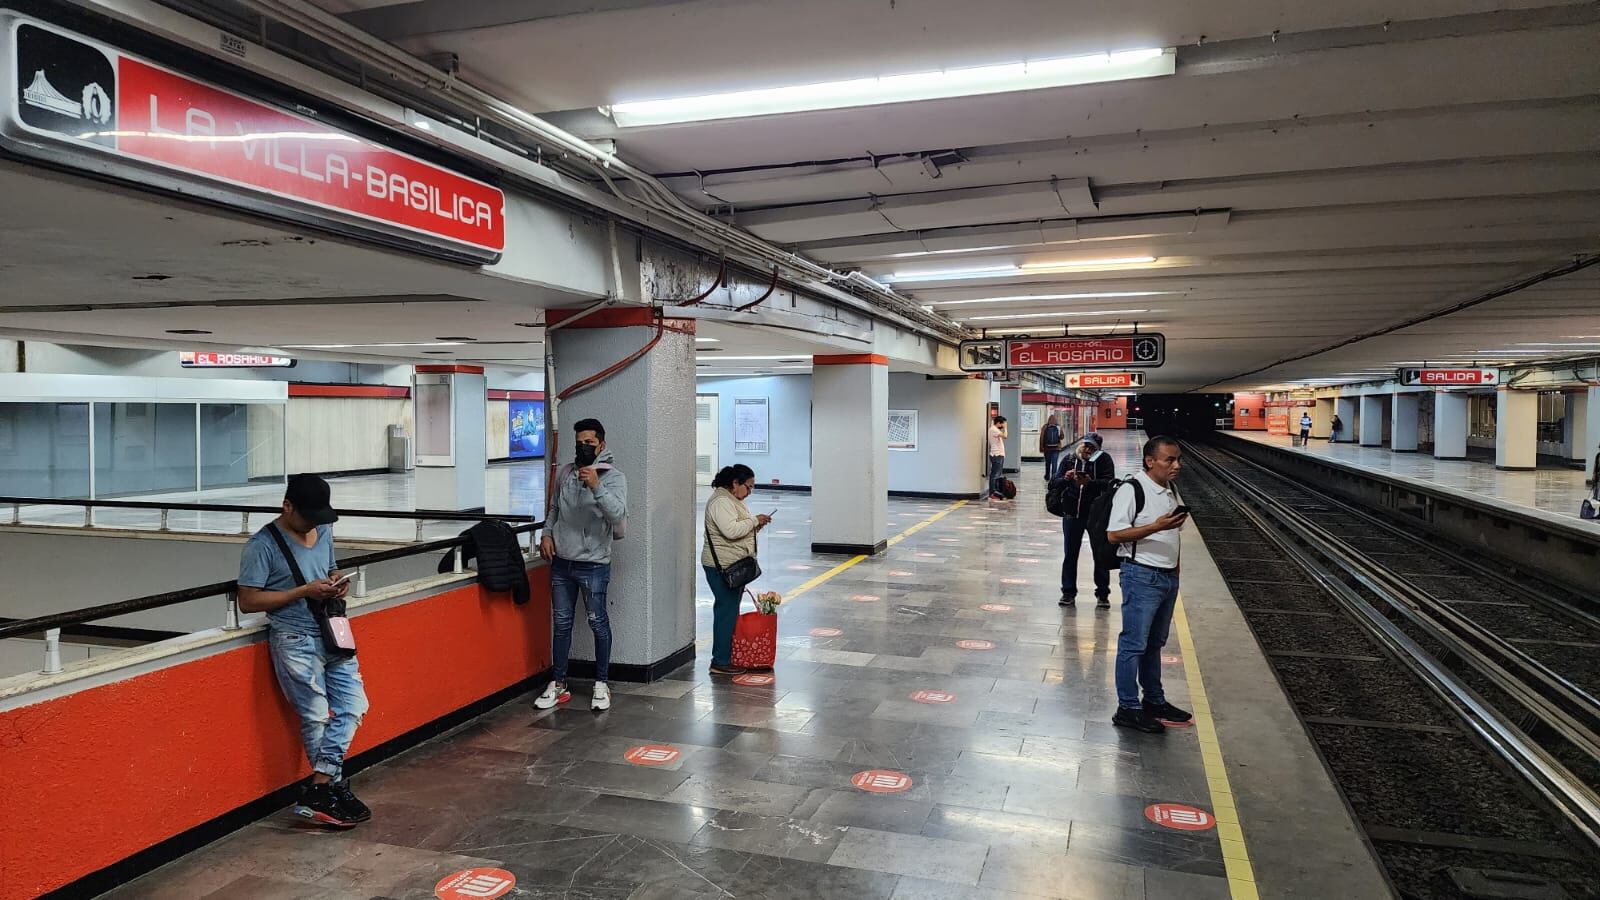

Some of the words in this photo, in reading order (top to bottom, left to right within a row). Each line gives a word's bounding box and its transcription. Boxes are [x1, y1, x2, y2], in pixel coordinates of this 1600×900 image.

[150, 94, 216, 149] LA
[235, 120, 491, 230] VILLA-BASILICA
[1019, 352, 1042, 362] EL
[1047, 349, 1123, 362] ROSARIO
[1084, 376, 1125, 385] SALIDA
[1426, 373, 1475, 381] SALIDA
